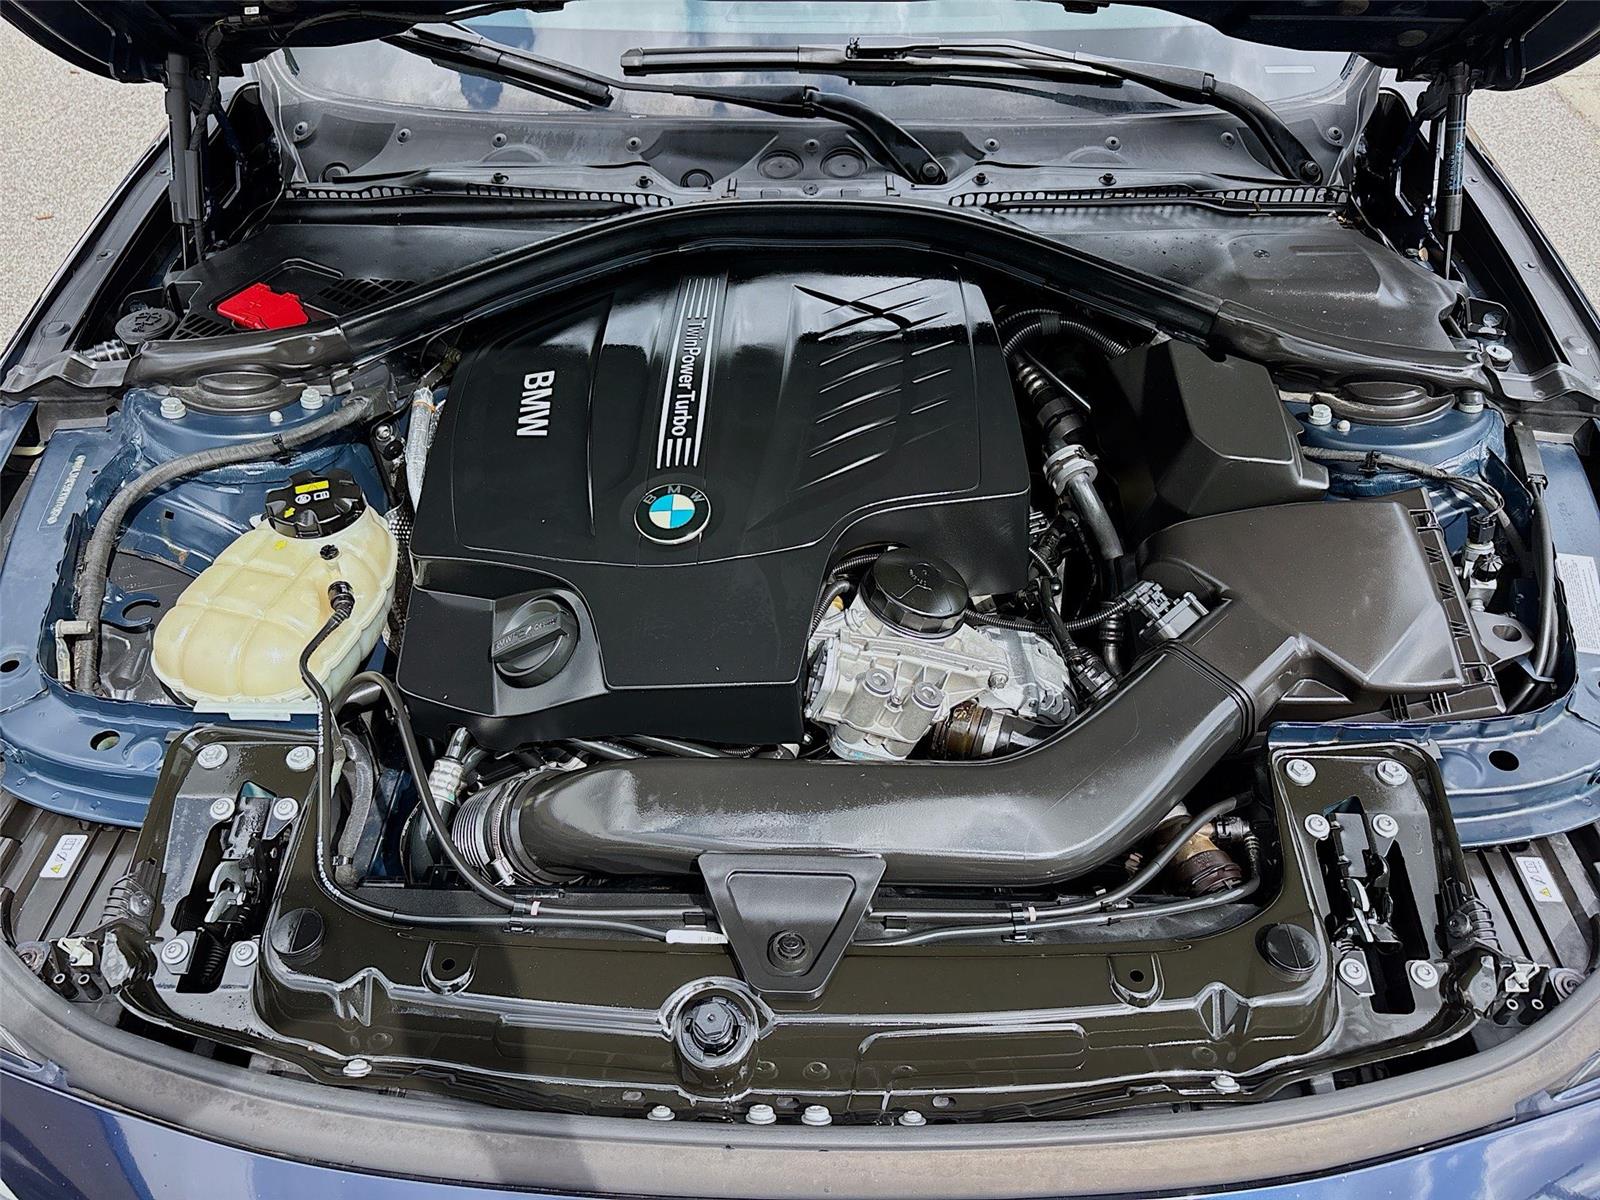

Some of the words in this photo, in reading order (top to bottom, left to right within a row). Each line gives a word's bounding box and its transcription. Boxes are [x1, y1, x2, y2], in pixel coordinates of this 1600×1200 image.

[678, 320, 706, 390] TwinPower
[516, 370, 555, 436] BMW
[671, 390, 696, 436] Turbo
[643, 485, 705, 504] BMW
